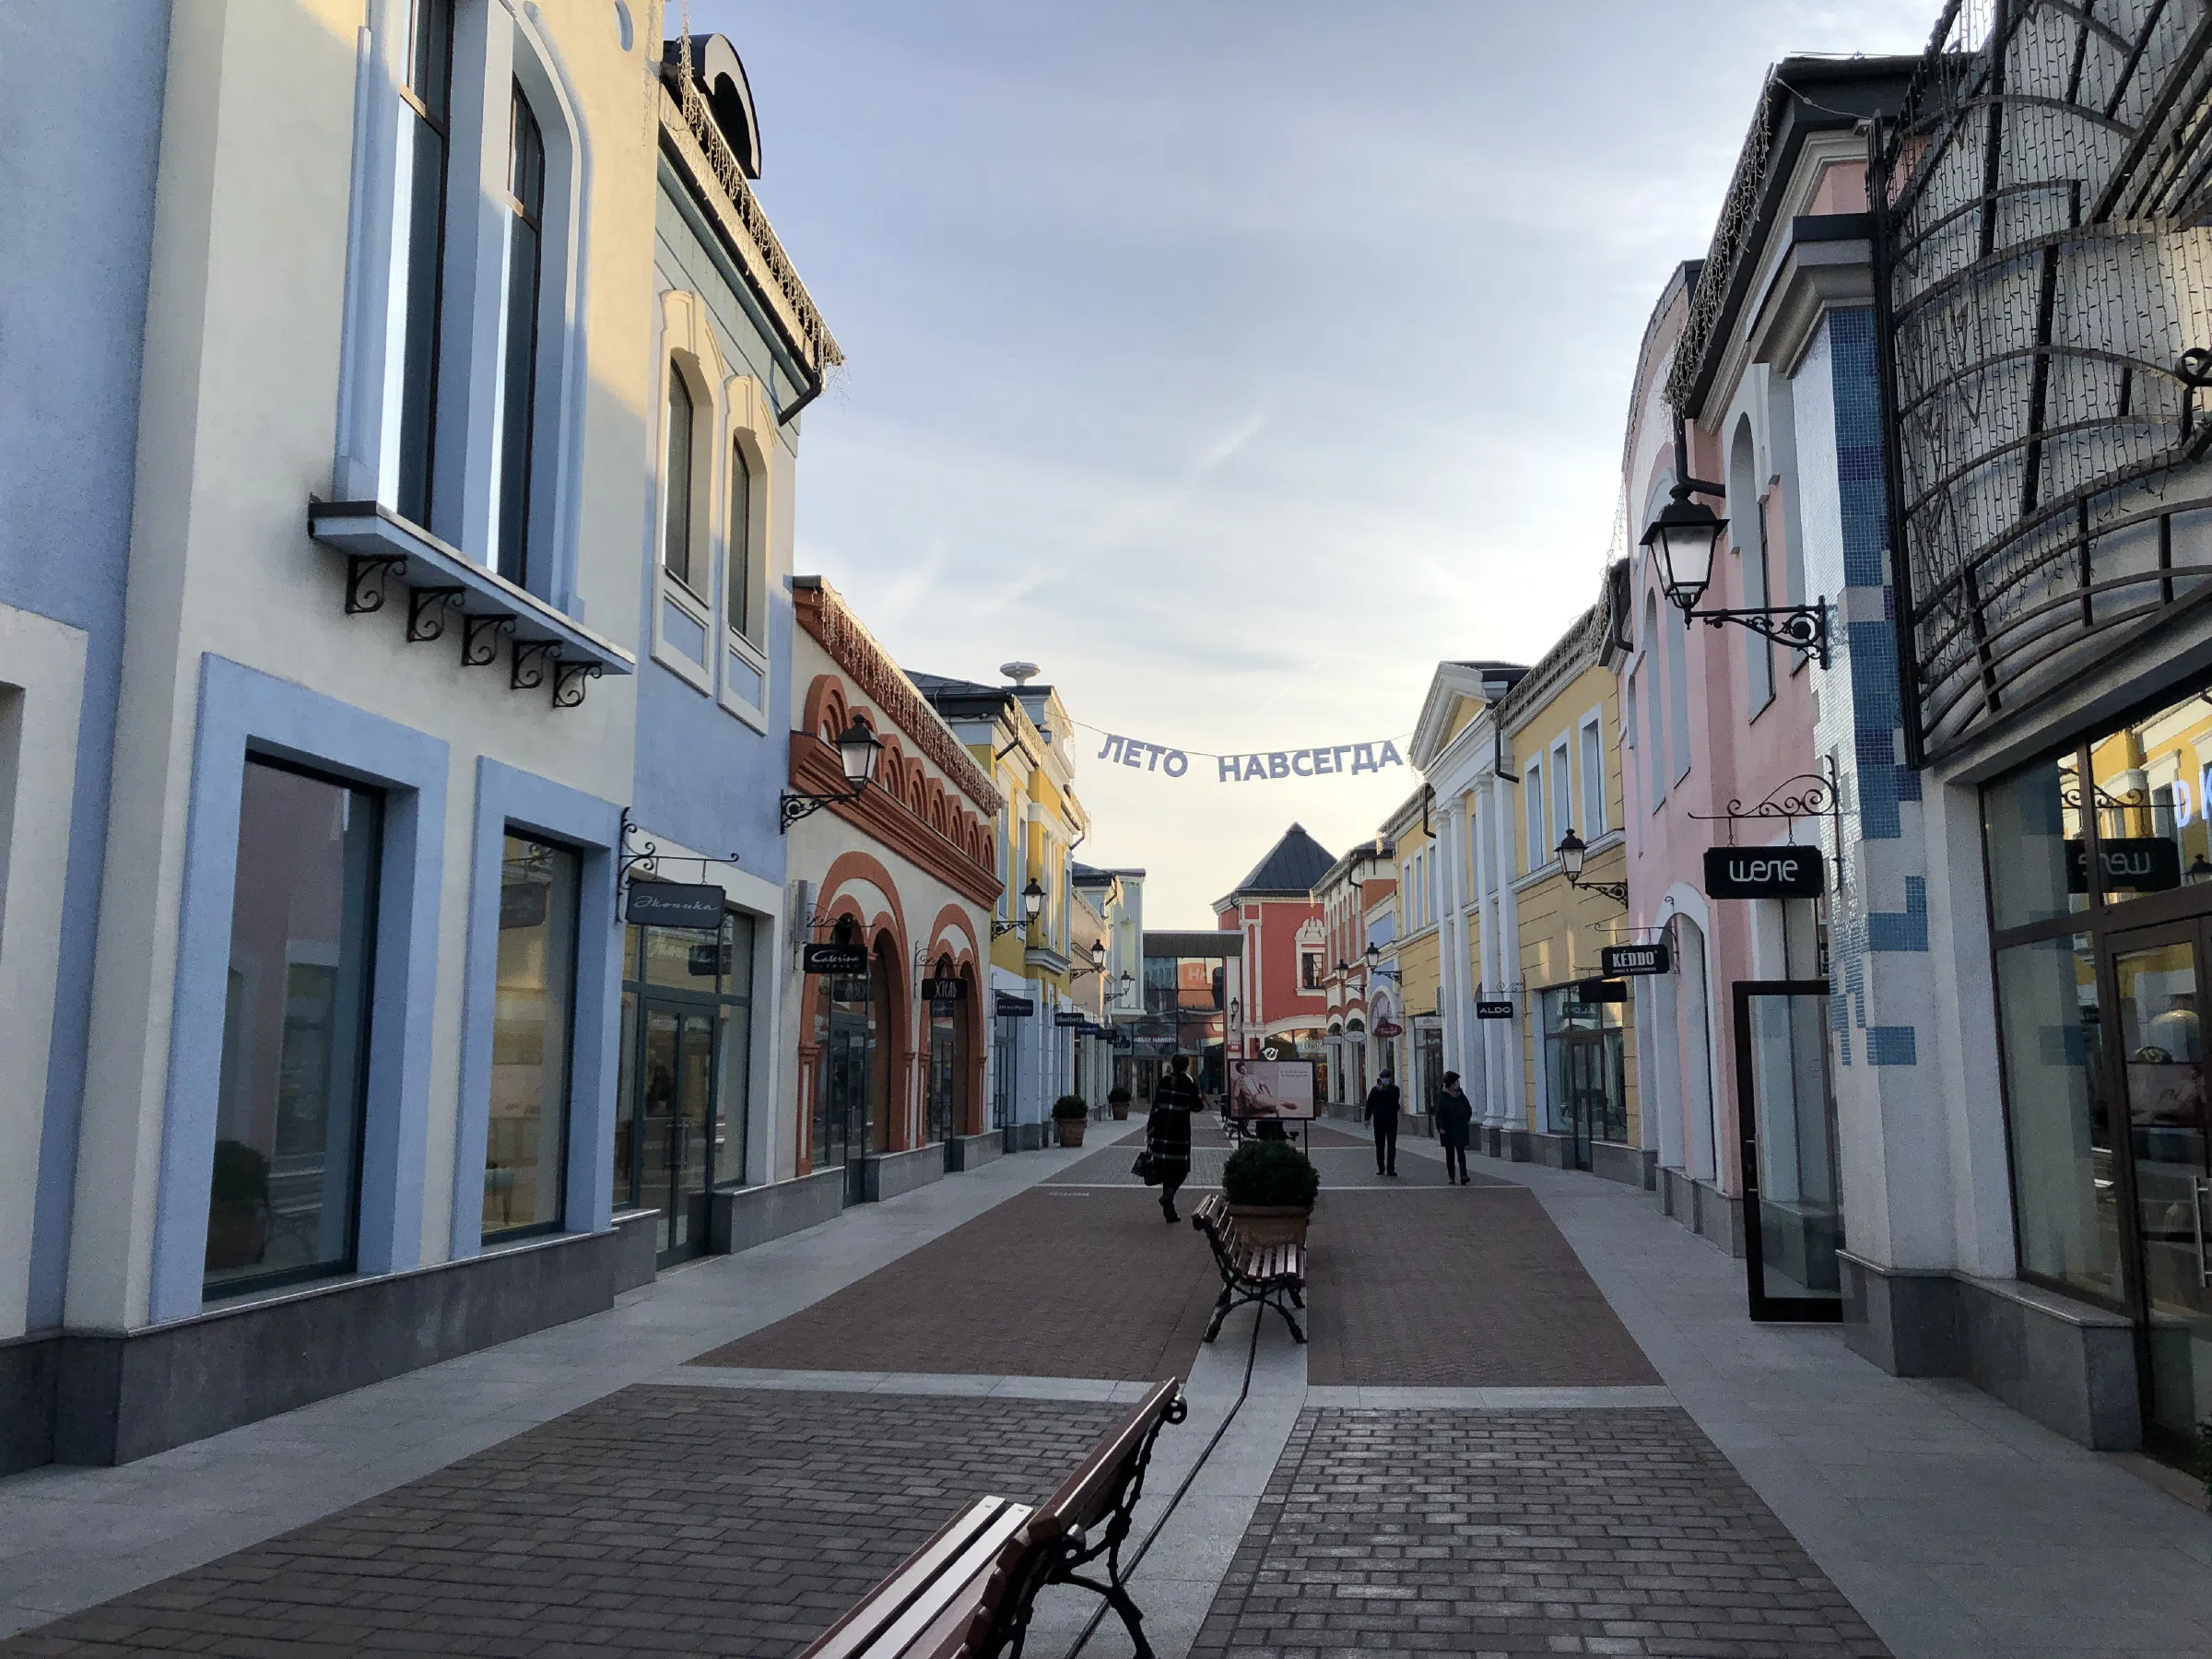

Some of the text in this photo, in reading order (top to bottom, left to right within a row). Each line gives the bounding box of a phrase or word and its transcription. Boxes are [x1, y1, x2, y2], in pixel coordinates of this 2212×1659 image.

[1098, 734, 1404, 782] ЛЕТО НАВСЕГДА
[633, 895, 720, 911] Эконика
[811, 949, 859, 963] Caterina
[1478, 1006, 1511, 1014] ALDO
